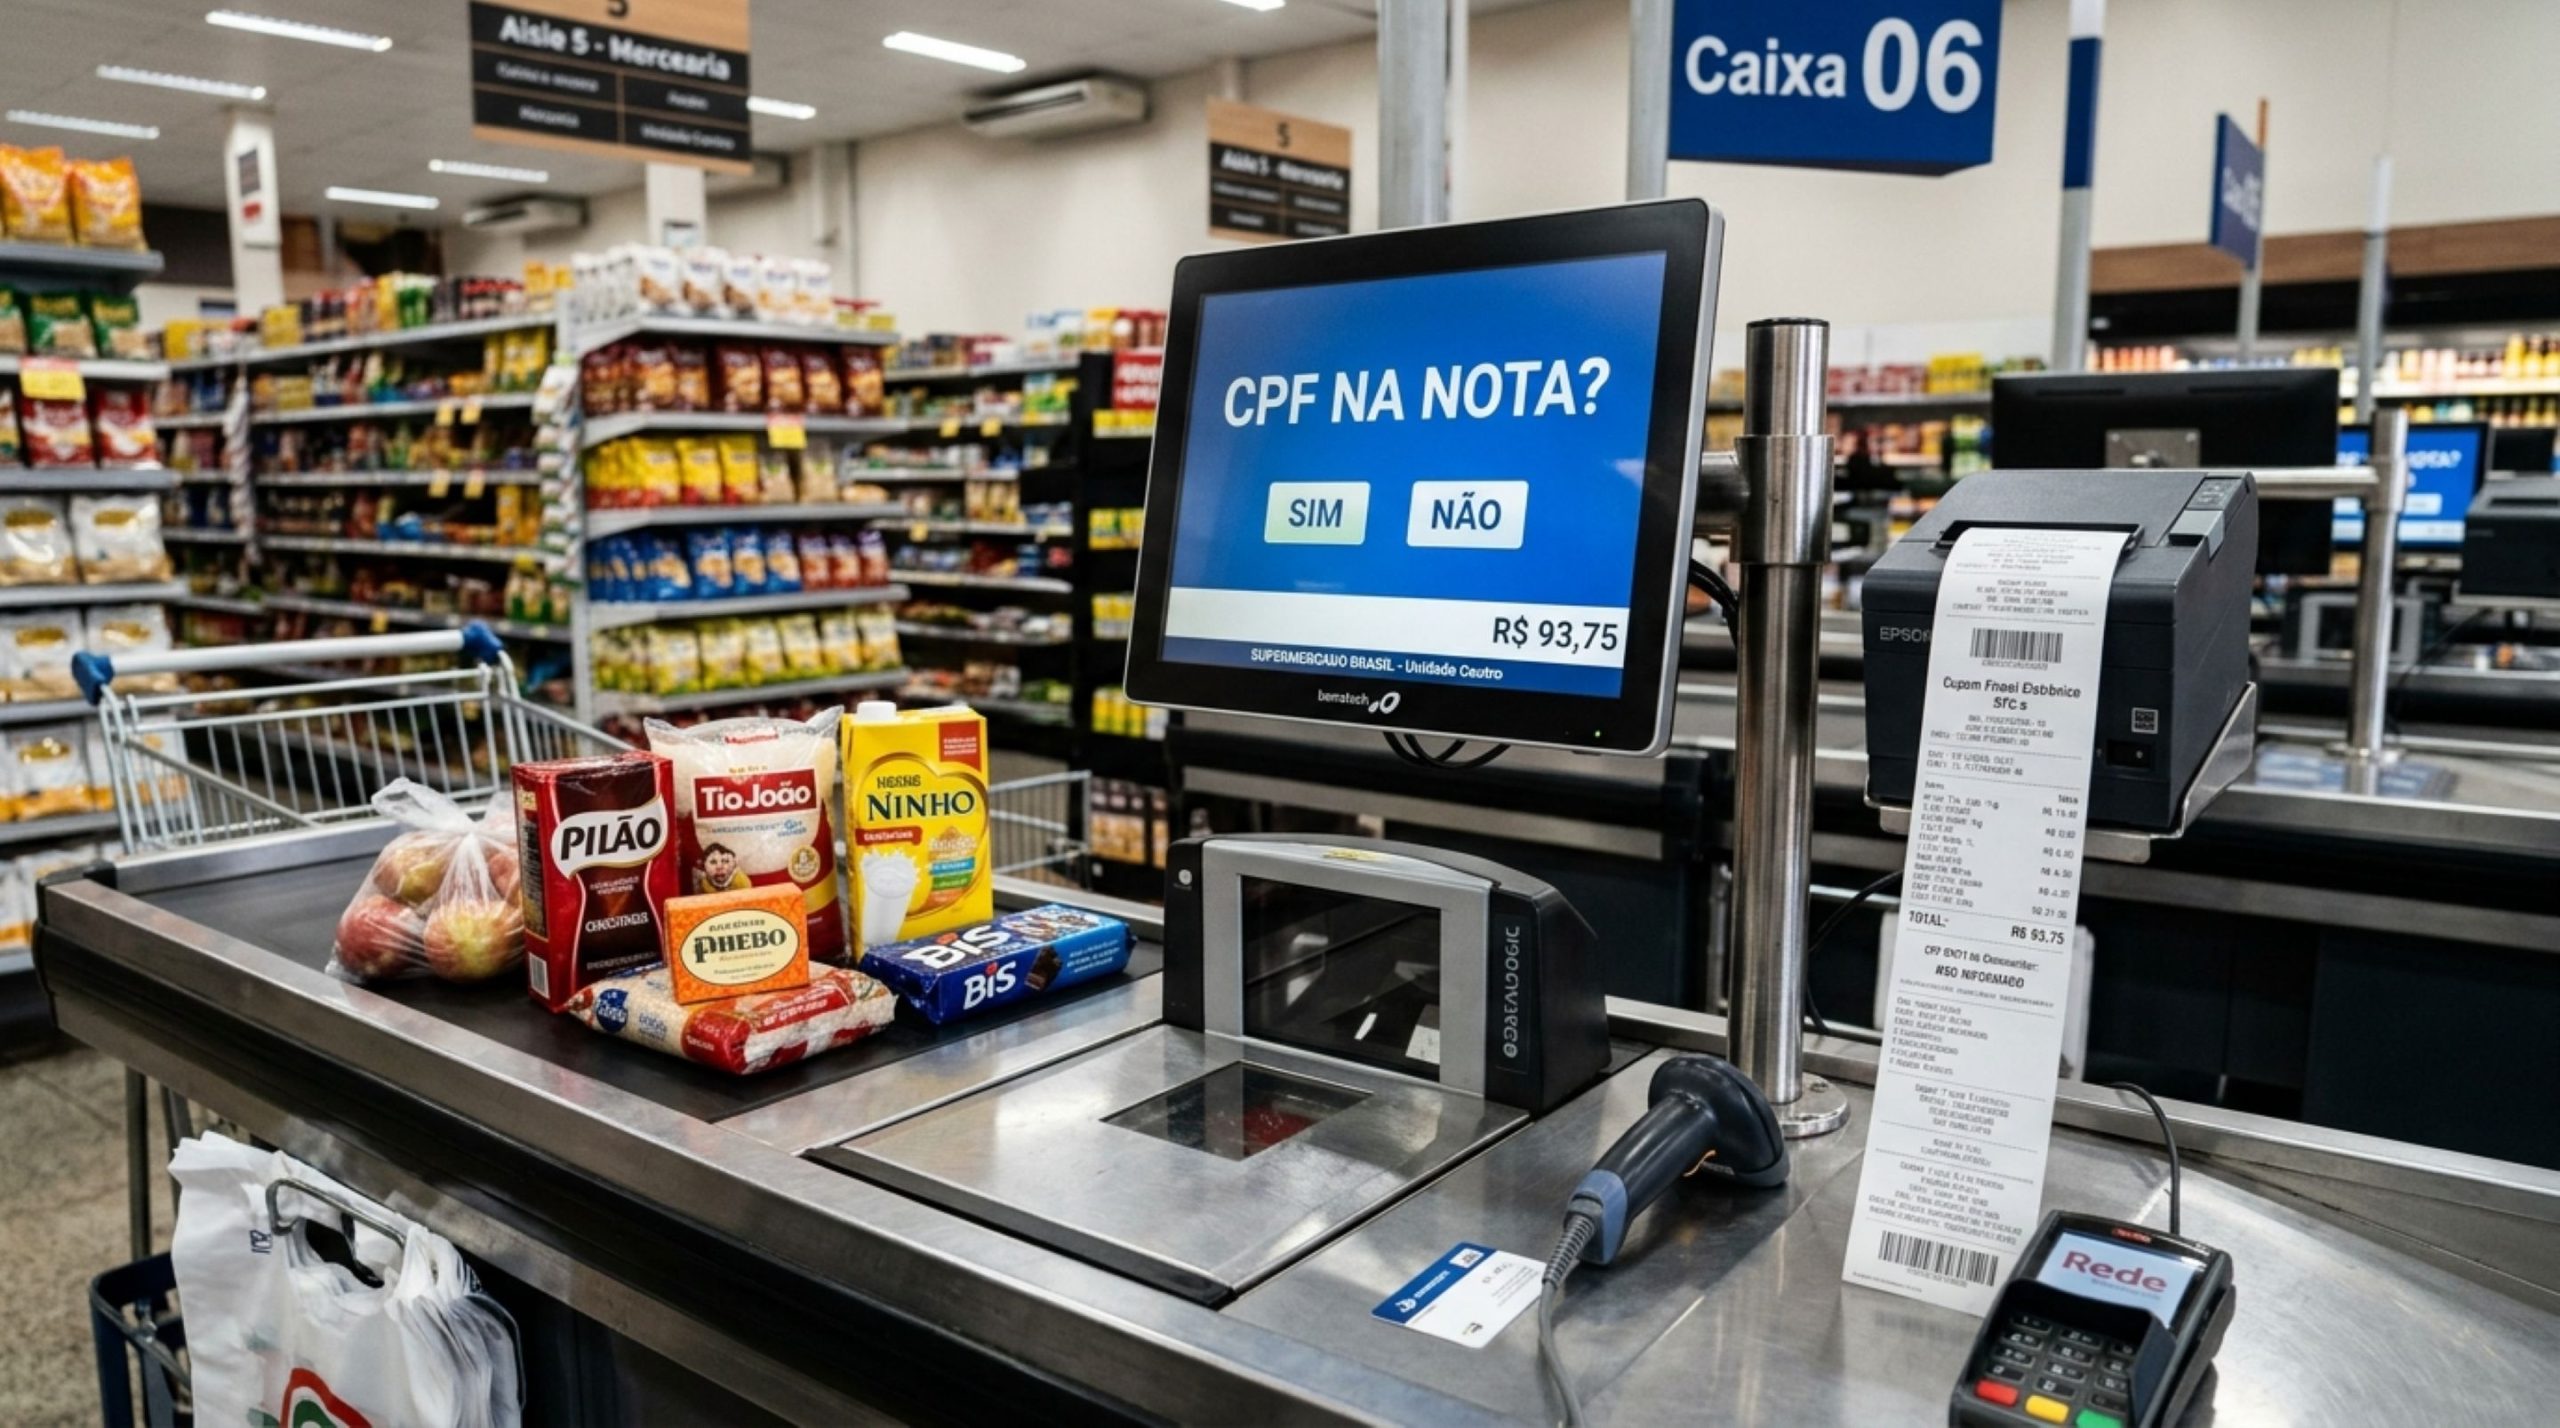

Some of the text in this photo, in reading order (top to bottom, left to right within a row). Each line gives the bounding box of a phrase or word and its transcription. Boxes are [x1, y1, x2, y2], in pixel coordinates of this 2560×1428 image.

[1684, 17, 1983, 114] Caixa 06
[1224, 372, 1320, 428] CPF
[1331, 368, 1404, 423] NA
[1421, 356, 1611, 420] NOTA?
[1288, 498, 1343, 529] SIM
[1431, 491, 1501, 530] NÃO
[1492, 615, 1618, 655] R$ 93,75
[1350, 655, 1394, 672] BRASIL
[701, 779, 811, 811] Tio João
[867, 790, 975, 821] NINHO
[561, 815, 661, 860] PILÃO
[694, 928, 787, 963] PHEBO
[2062, 1250, 2168, 1293] Rede
